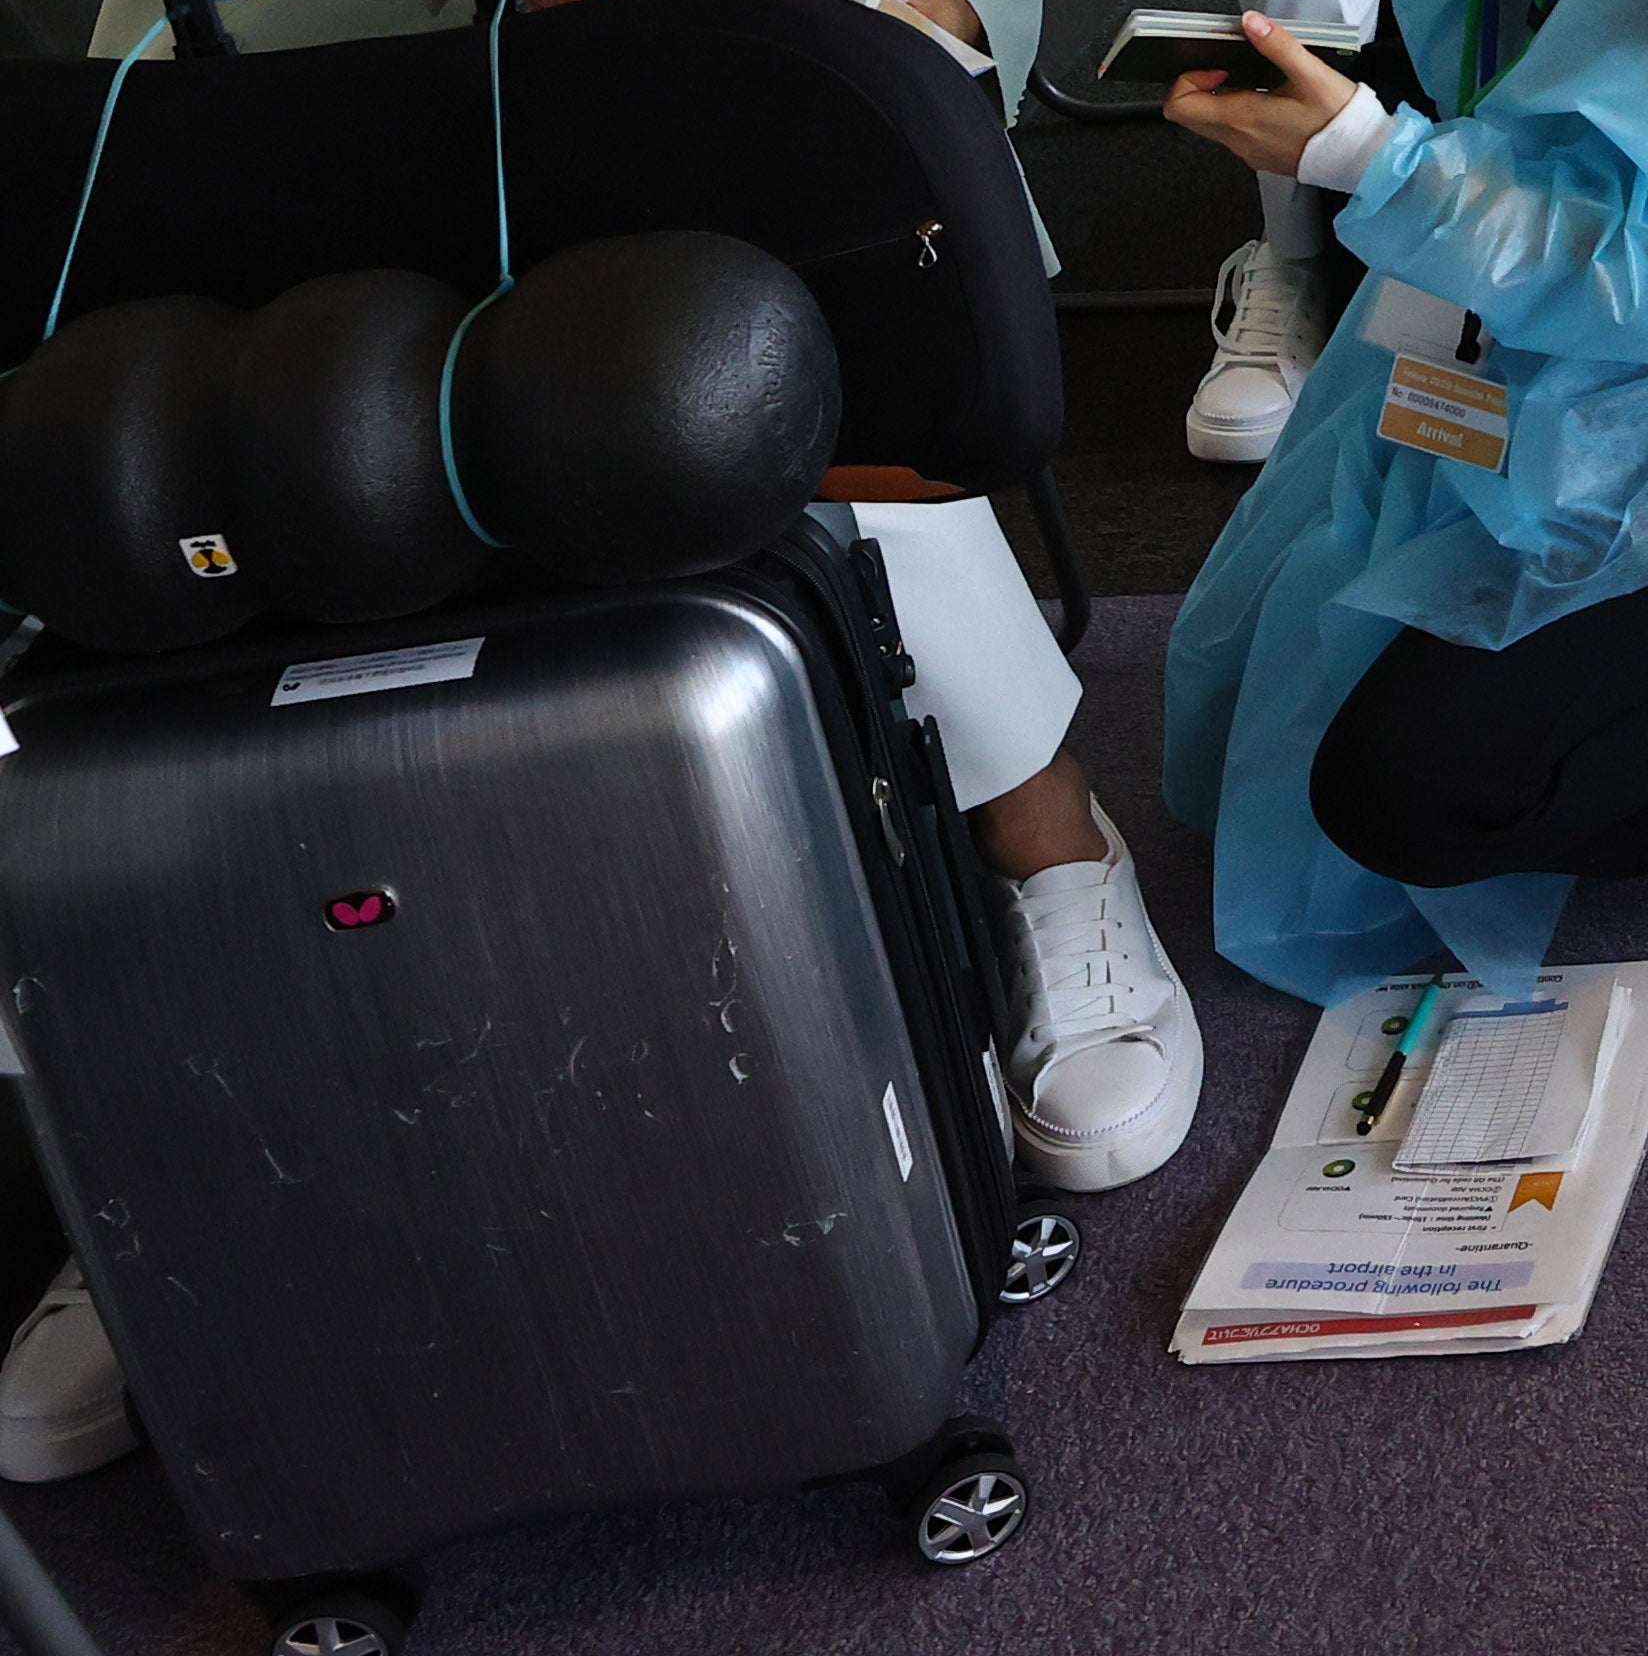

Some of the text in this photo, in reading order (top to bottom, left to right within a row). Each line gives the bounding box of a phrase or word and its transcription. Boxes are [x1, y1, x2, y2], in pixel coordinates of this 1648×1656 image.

[1416, 421, 1465, 448] Arrival
[1326, 1261, 1457, 1279] in the airport
[1265, 1275, 1503, 1297] The following procedure
